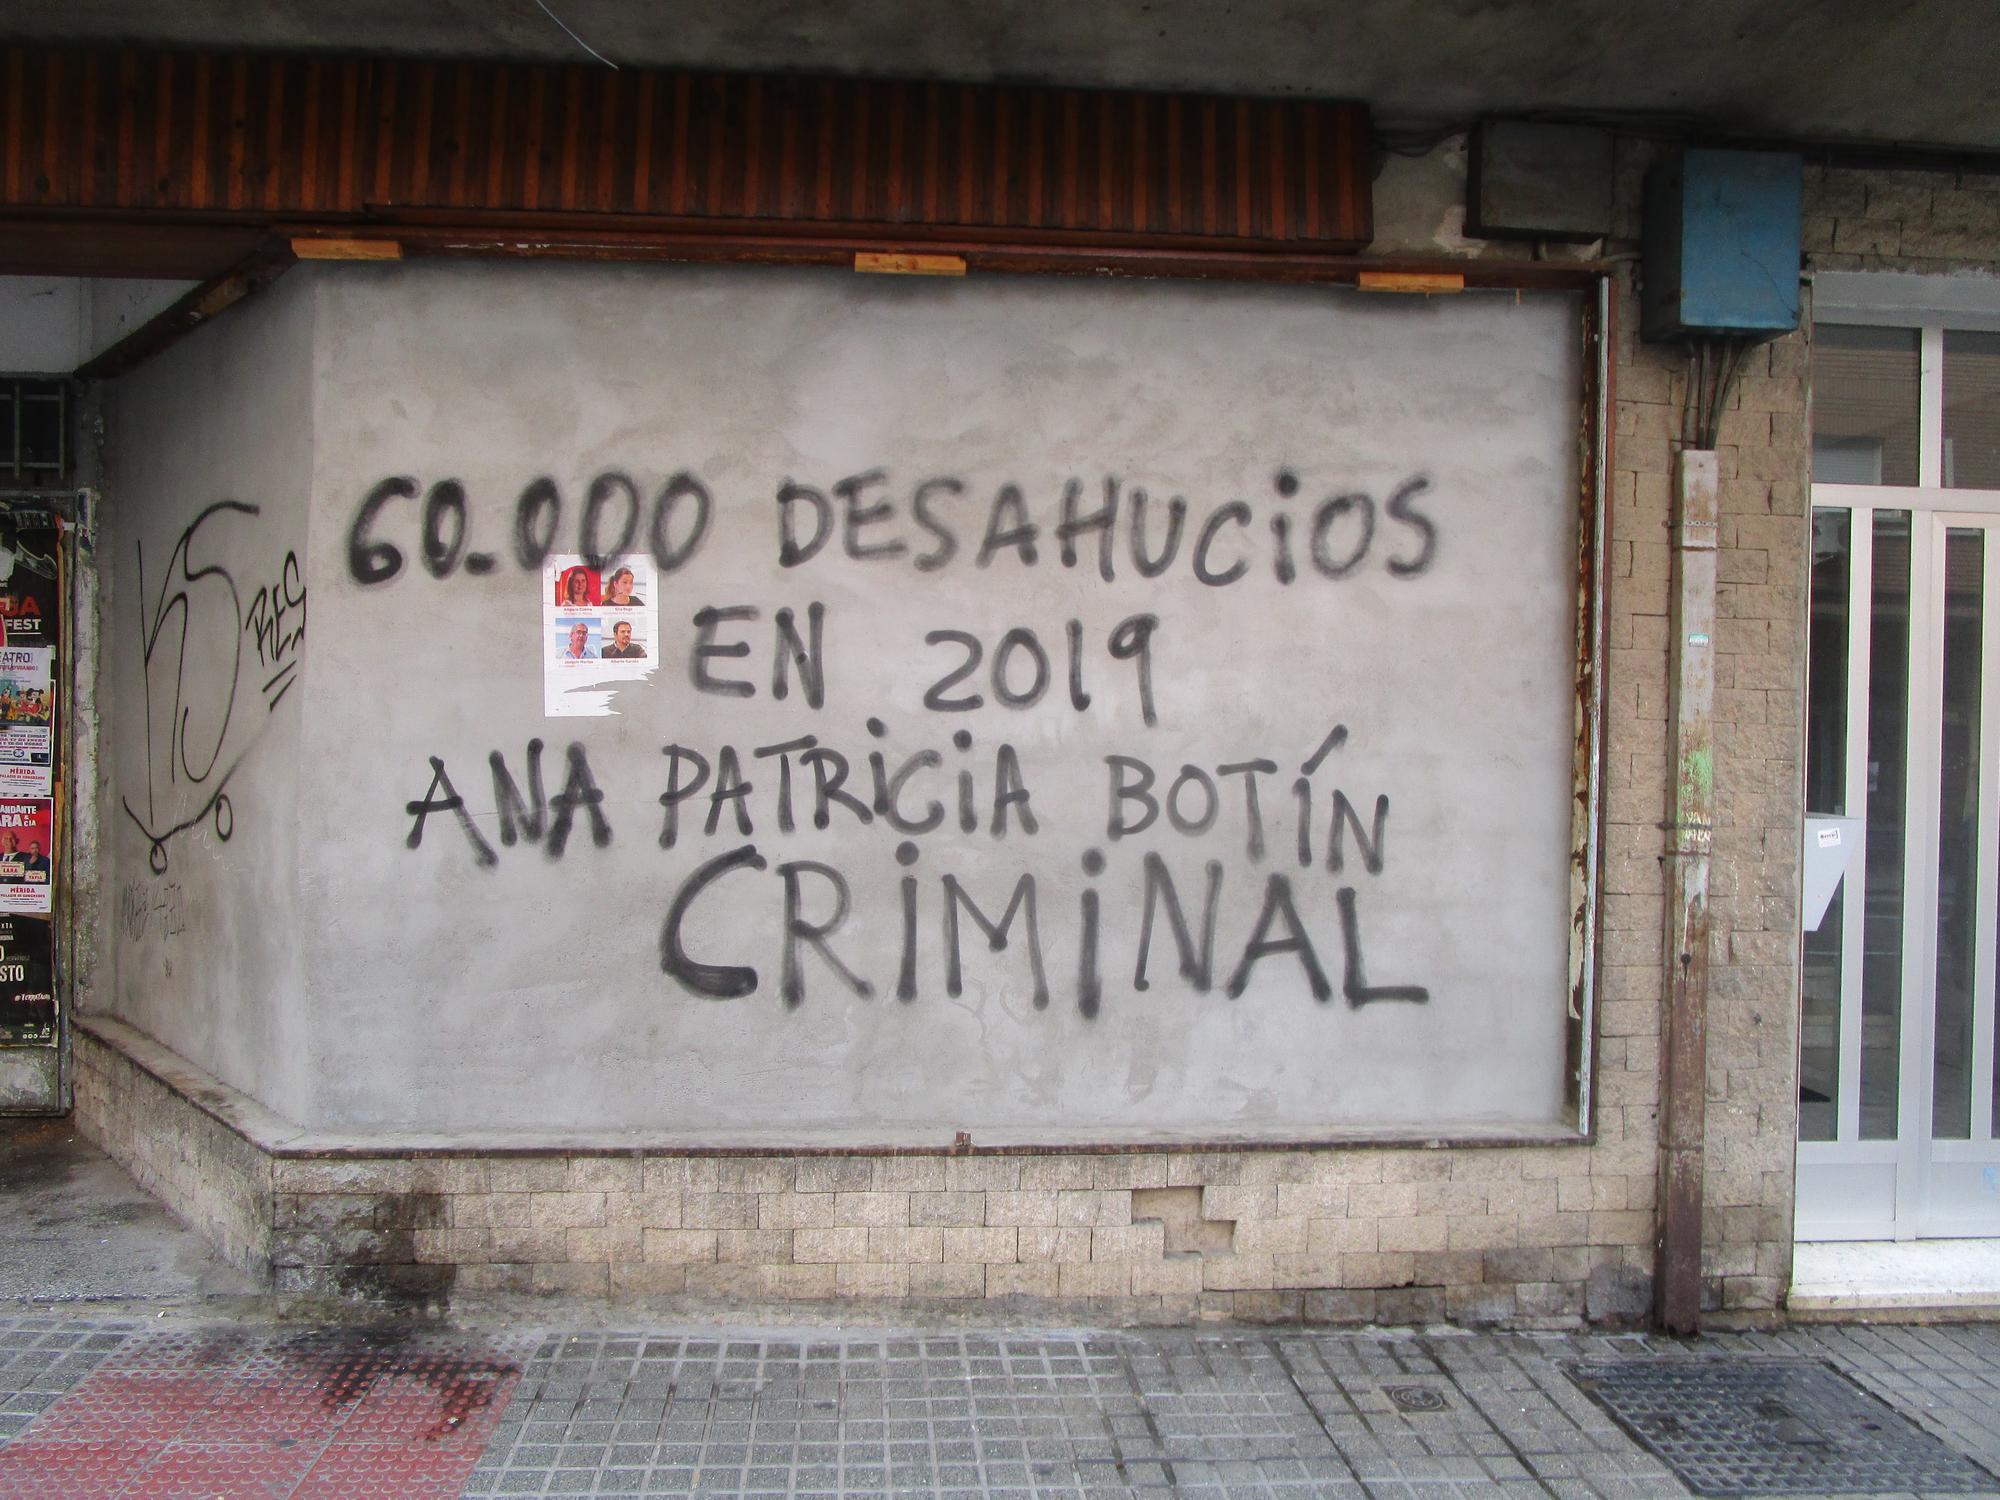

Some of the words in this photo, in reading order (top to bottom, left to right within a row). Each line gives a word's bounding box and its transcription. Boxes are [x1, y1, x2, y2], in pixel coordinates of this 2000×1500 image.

[345, 469, 710, 590] 60.000
[688, 598, 828, 712] EN
[923, 607, 1158, 729] 2019
[9, 767, 36, 775] MÉRIDA
[405, 738, 614, 869] ANA
[1103, 723, 1390, 877] BOTÍN
[10, 886, 36, 894] MÉRIDA
